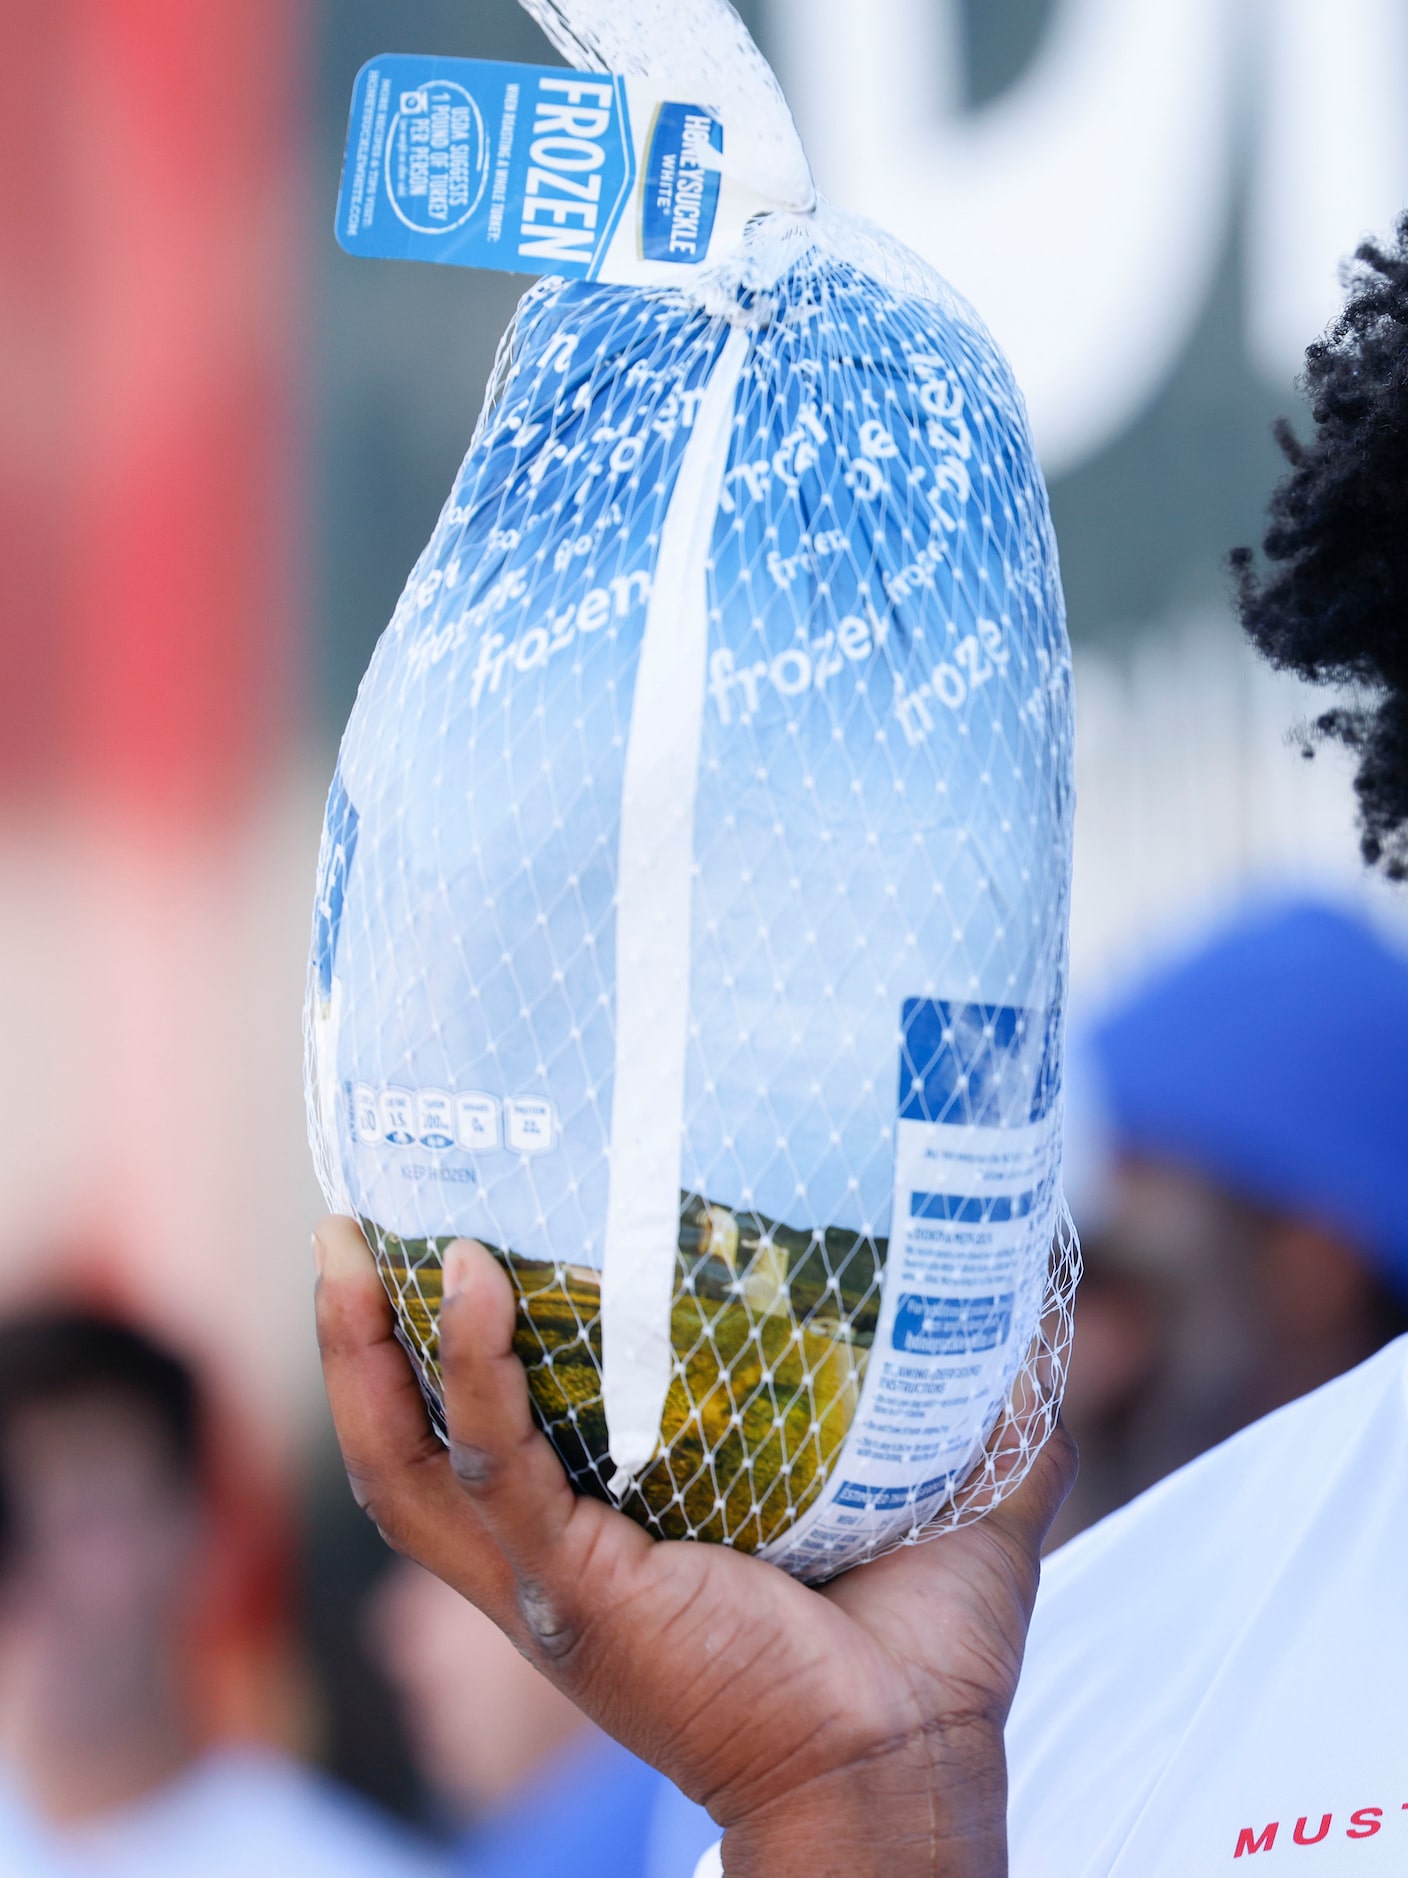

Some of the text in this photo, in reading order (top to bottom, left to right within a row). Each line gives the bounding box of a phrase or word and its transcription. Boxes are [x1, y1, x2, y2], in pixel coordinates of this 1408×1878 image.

[495, 113, 515, 158] ROASTING
[502, 84, 519, 109] WHEN
[409, 118, 429, 196] PER PERSON
[428, 92, 450, 220] 1 POUND OF TURKEY
[449, 107, 470, 206] USDA SUGGESTS
[491, 169, 510, 201] WHOLE
[519, 78, 613, 263] FROZEN
[470, 569, 655, 708] frozen
